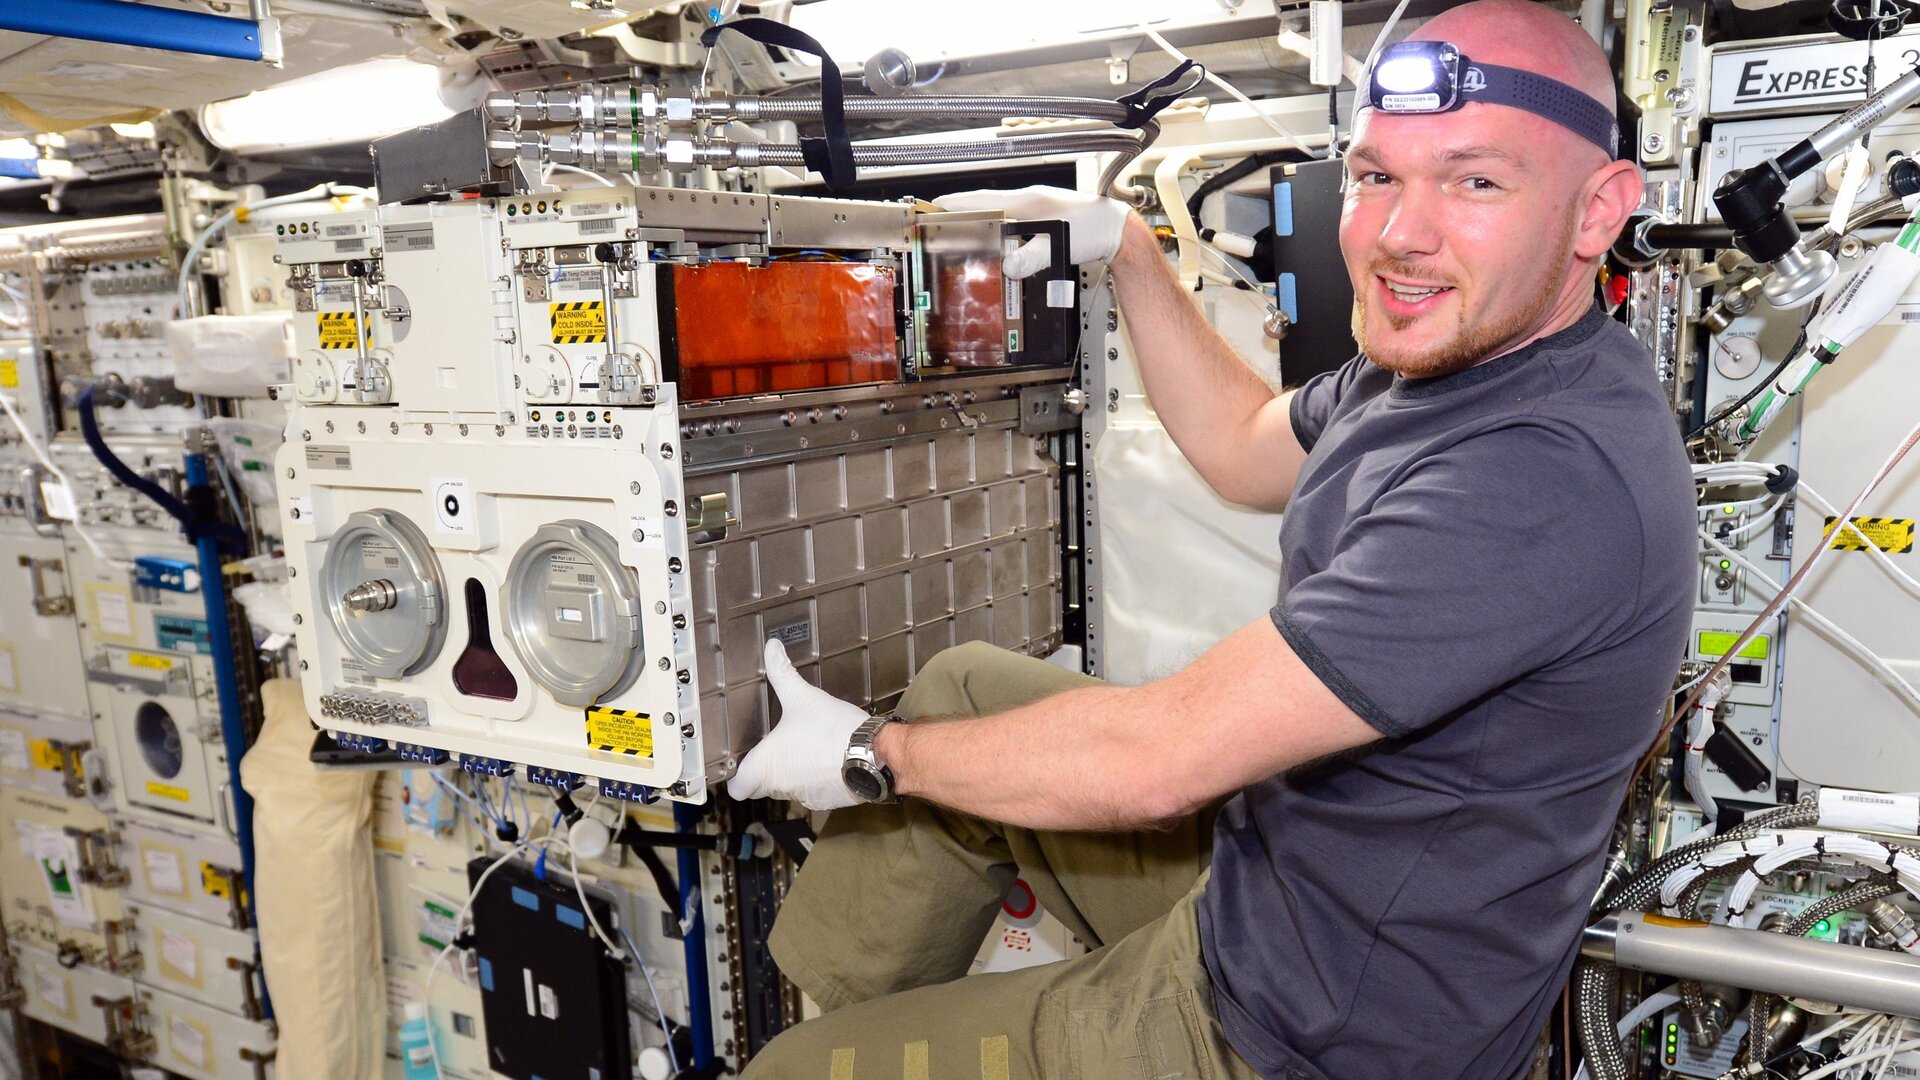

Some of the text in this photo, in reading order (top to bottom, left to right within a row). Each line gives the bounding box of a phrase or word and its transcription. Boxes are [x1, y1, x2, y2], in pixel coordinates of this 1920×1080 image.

[1839, 105, 1867, 125] MULTIUSE
[1866, 93, 1886, 107] BRCKT
[557, 311, 587, 319] WARNING
[575, 320, 593, 328] INSIDE
[787, 623, 808, 634] astrium
[612, 717, 635, 725] CAUTION
[608, 722, 633, 730] INCUBATOR
[594, 737, 622, 745] EXTRACTION
[1762, 895, 1794, 905] LOCKER
